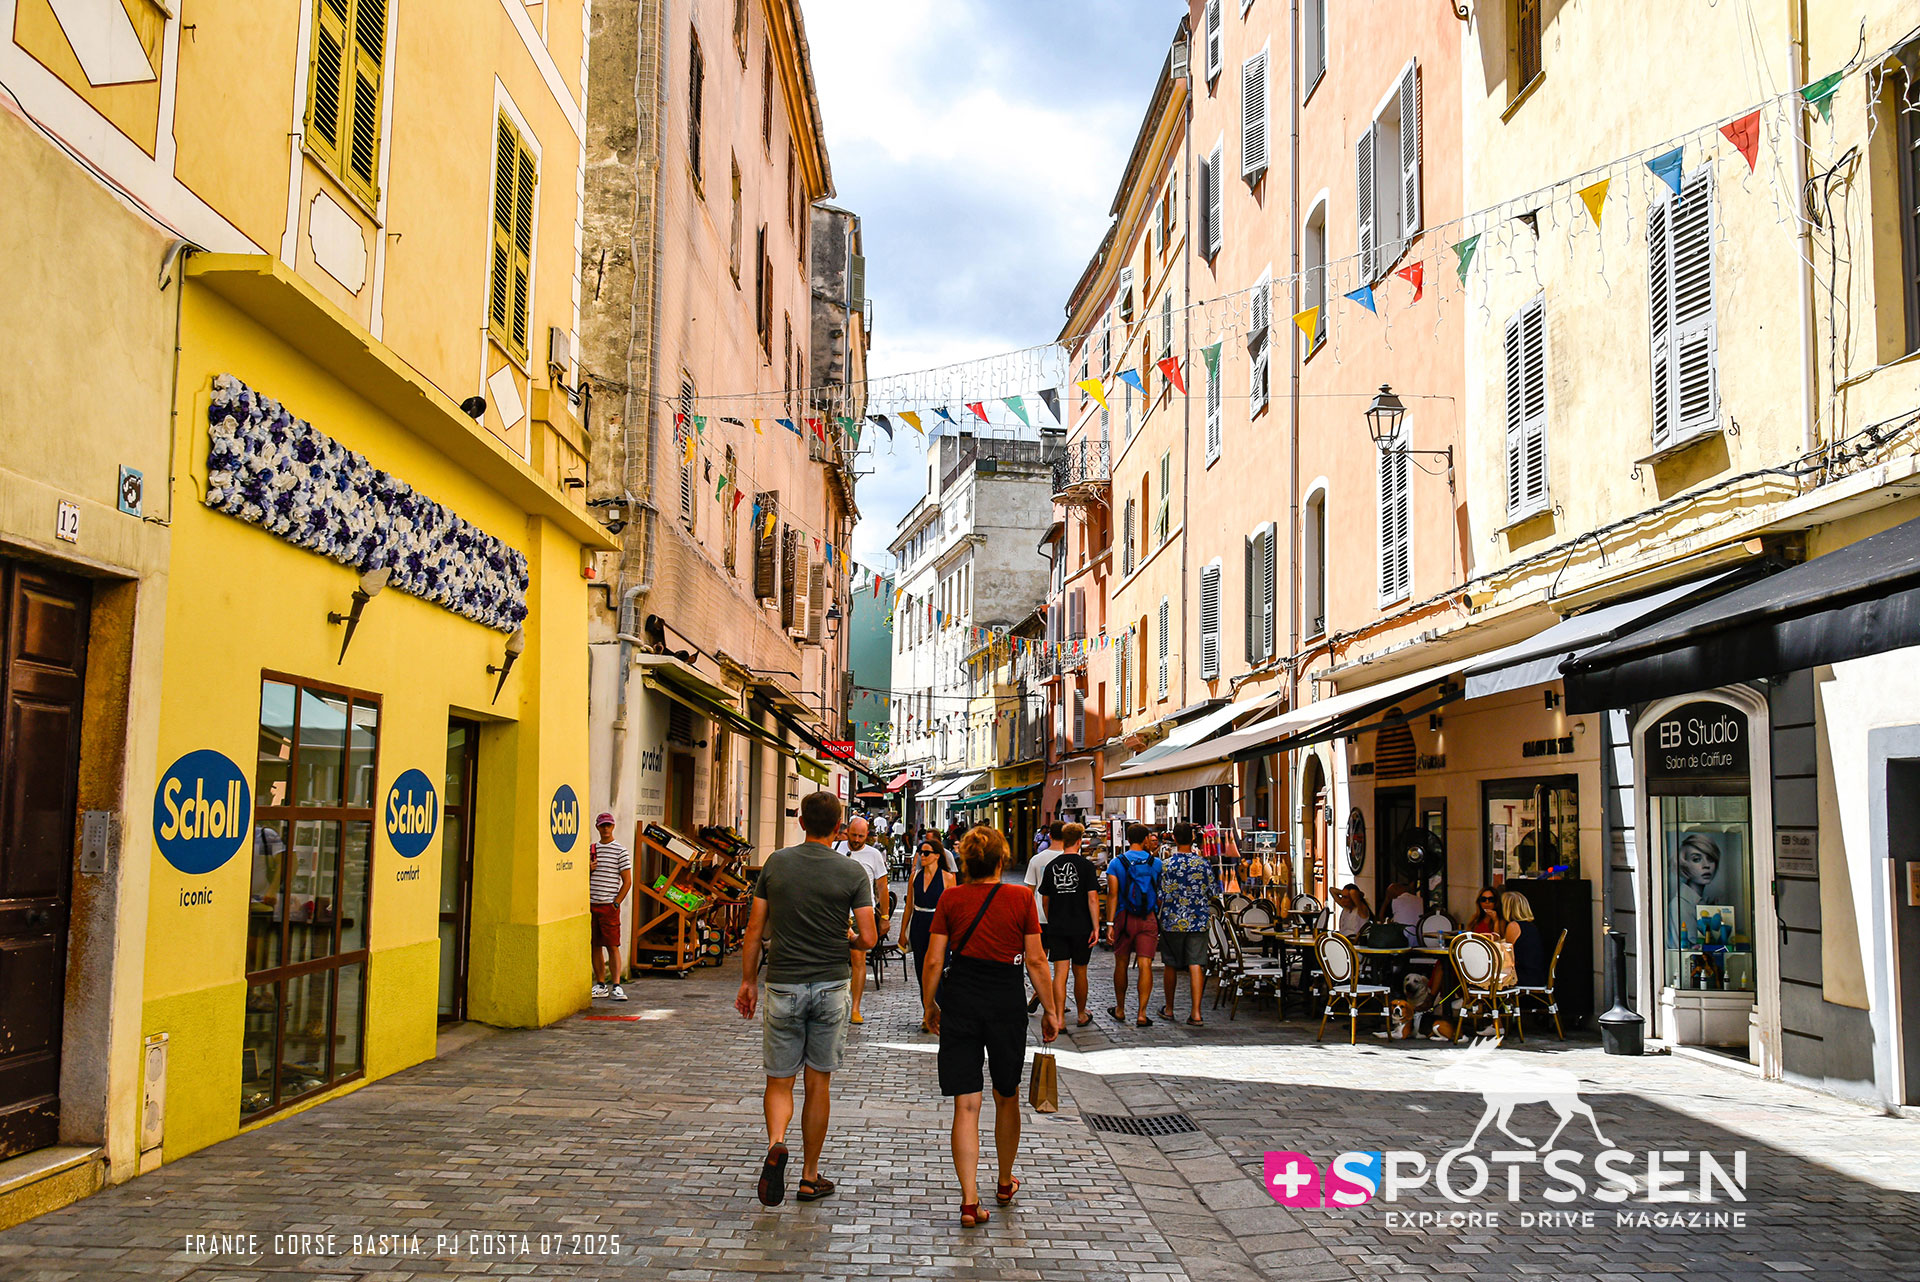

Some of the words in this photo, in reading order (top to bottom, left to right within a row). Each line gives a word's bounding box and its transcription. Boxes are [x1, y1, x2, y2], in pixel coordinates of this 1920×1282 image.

[60, 510, 78, 535] 12
[1660, 721, 1682, 749] EB
[1687, 714, 1739, 746] Studio
[1665, 754, 1686, 770] Salon
[1688, 754, 1699, 768] de
[1700, 751, 1733, 767] Coiffure
[160, 777, 241, 841] Scholl
[388, 788, 434, 834] Scholl
[552, 800, 577, 835] Scholl
[396, 865, 420, 882] comfort
[179, 886, 213, 907] iconic
